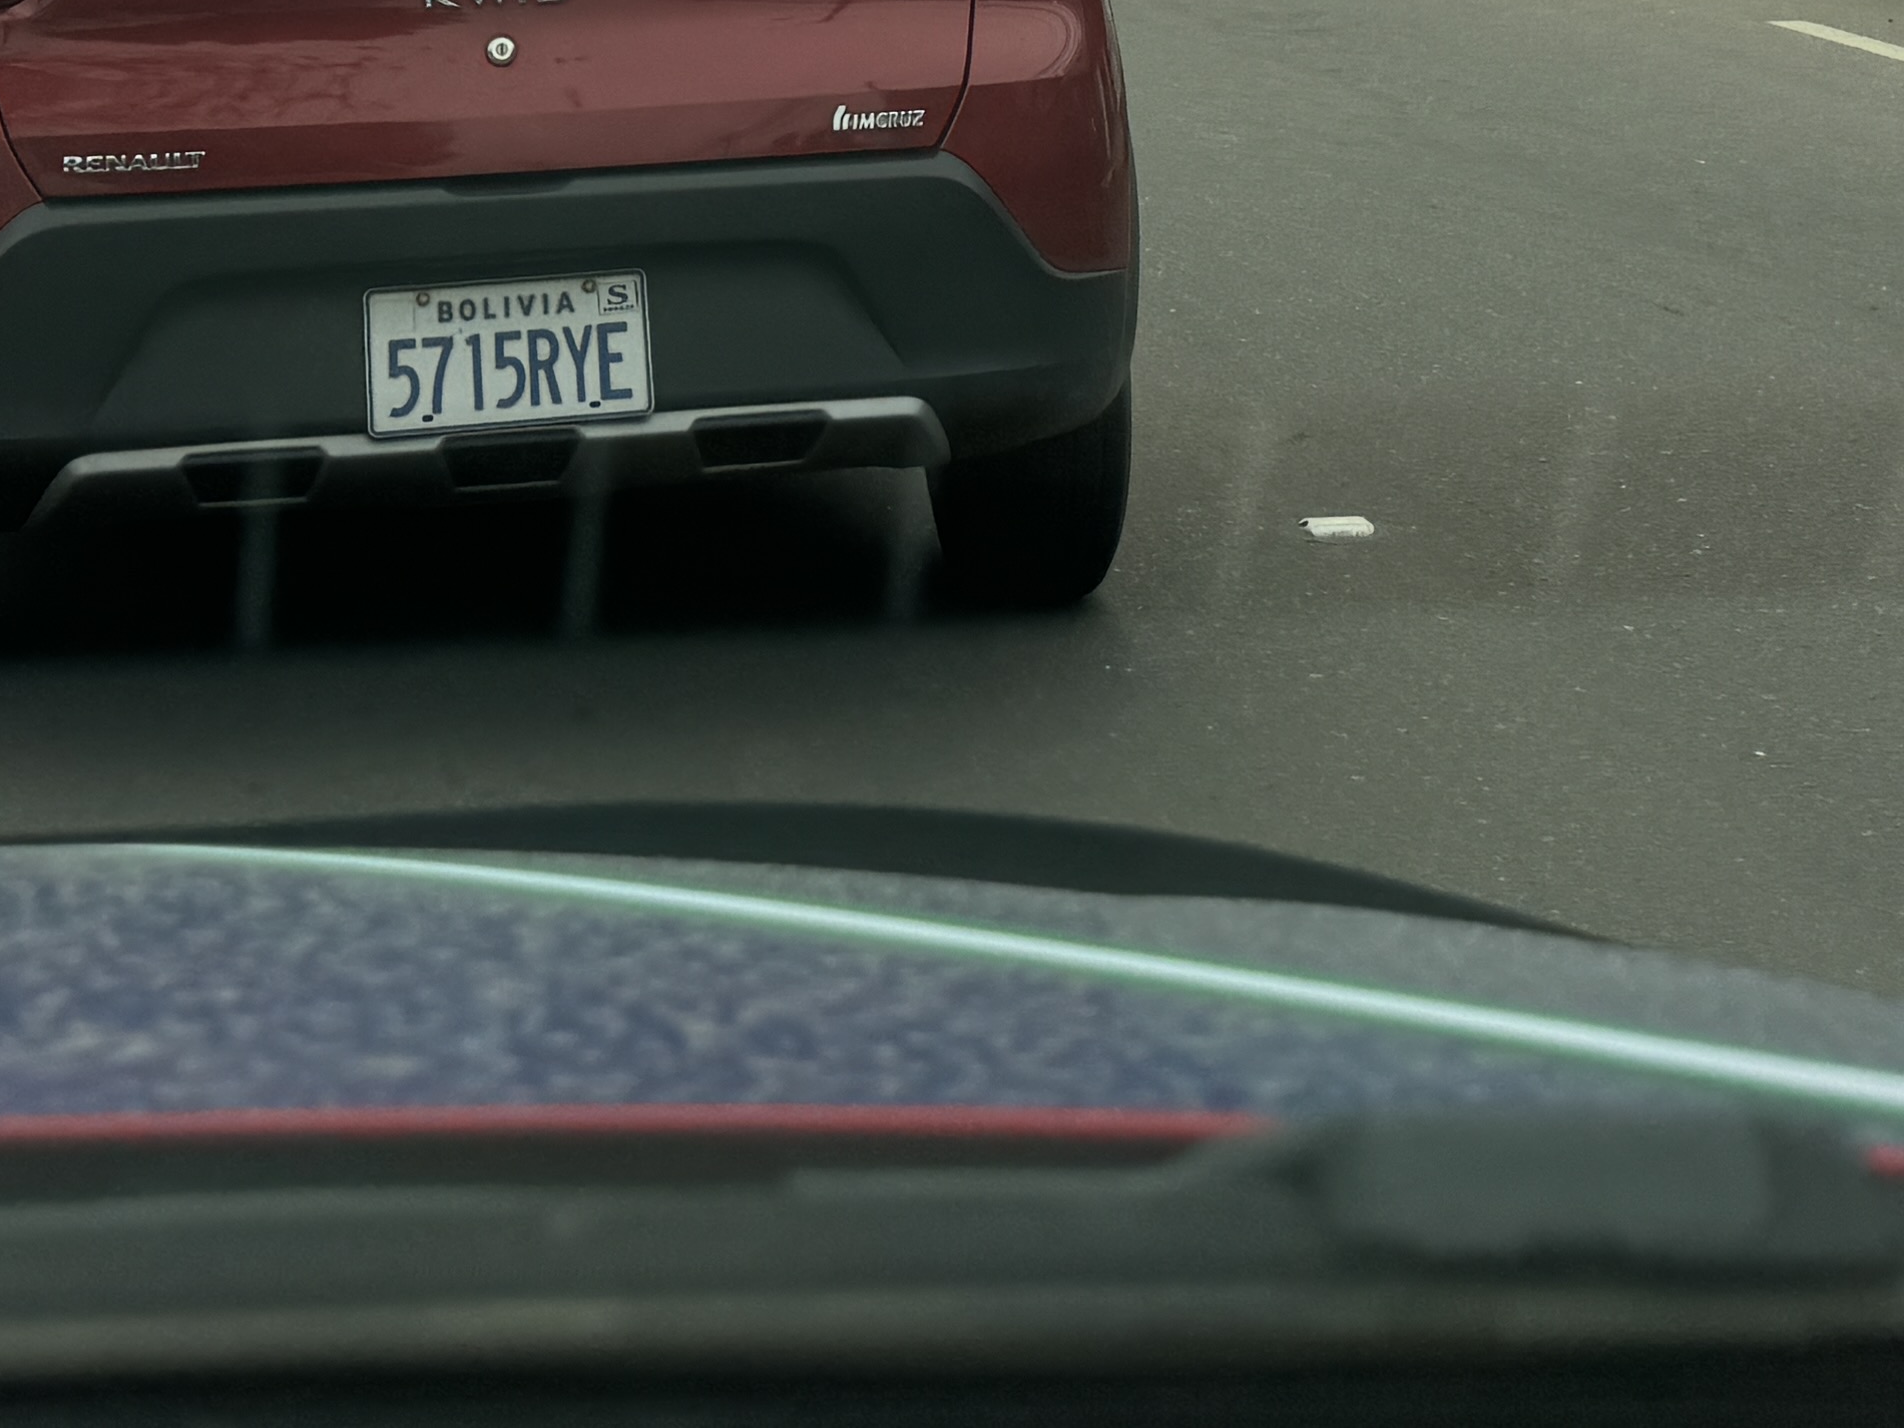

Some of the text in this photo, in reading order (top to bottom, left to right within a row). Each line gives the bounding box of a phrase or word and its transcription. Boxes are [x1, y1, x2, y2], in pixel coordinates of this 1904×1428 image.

[63, 150, 207, 173] RENAULT
[437, 284, 629, 324] BOLIVIA S
[387, 321, 634, 419] 5715RYE
